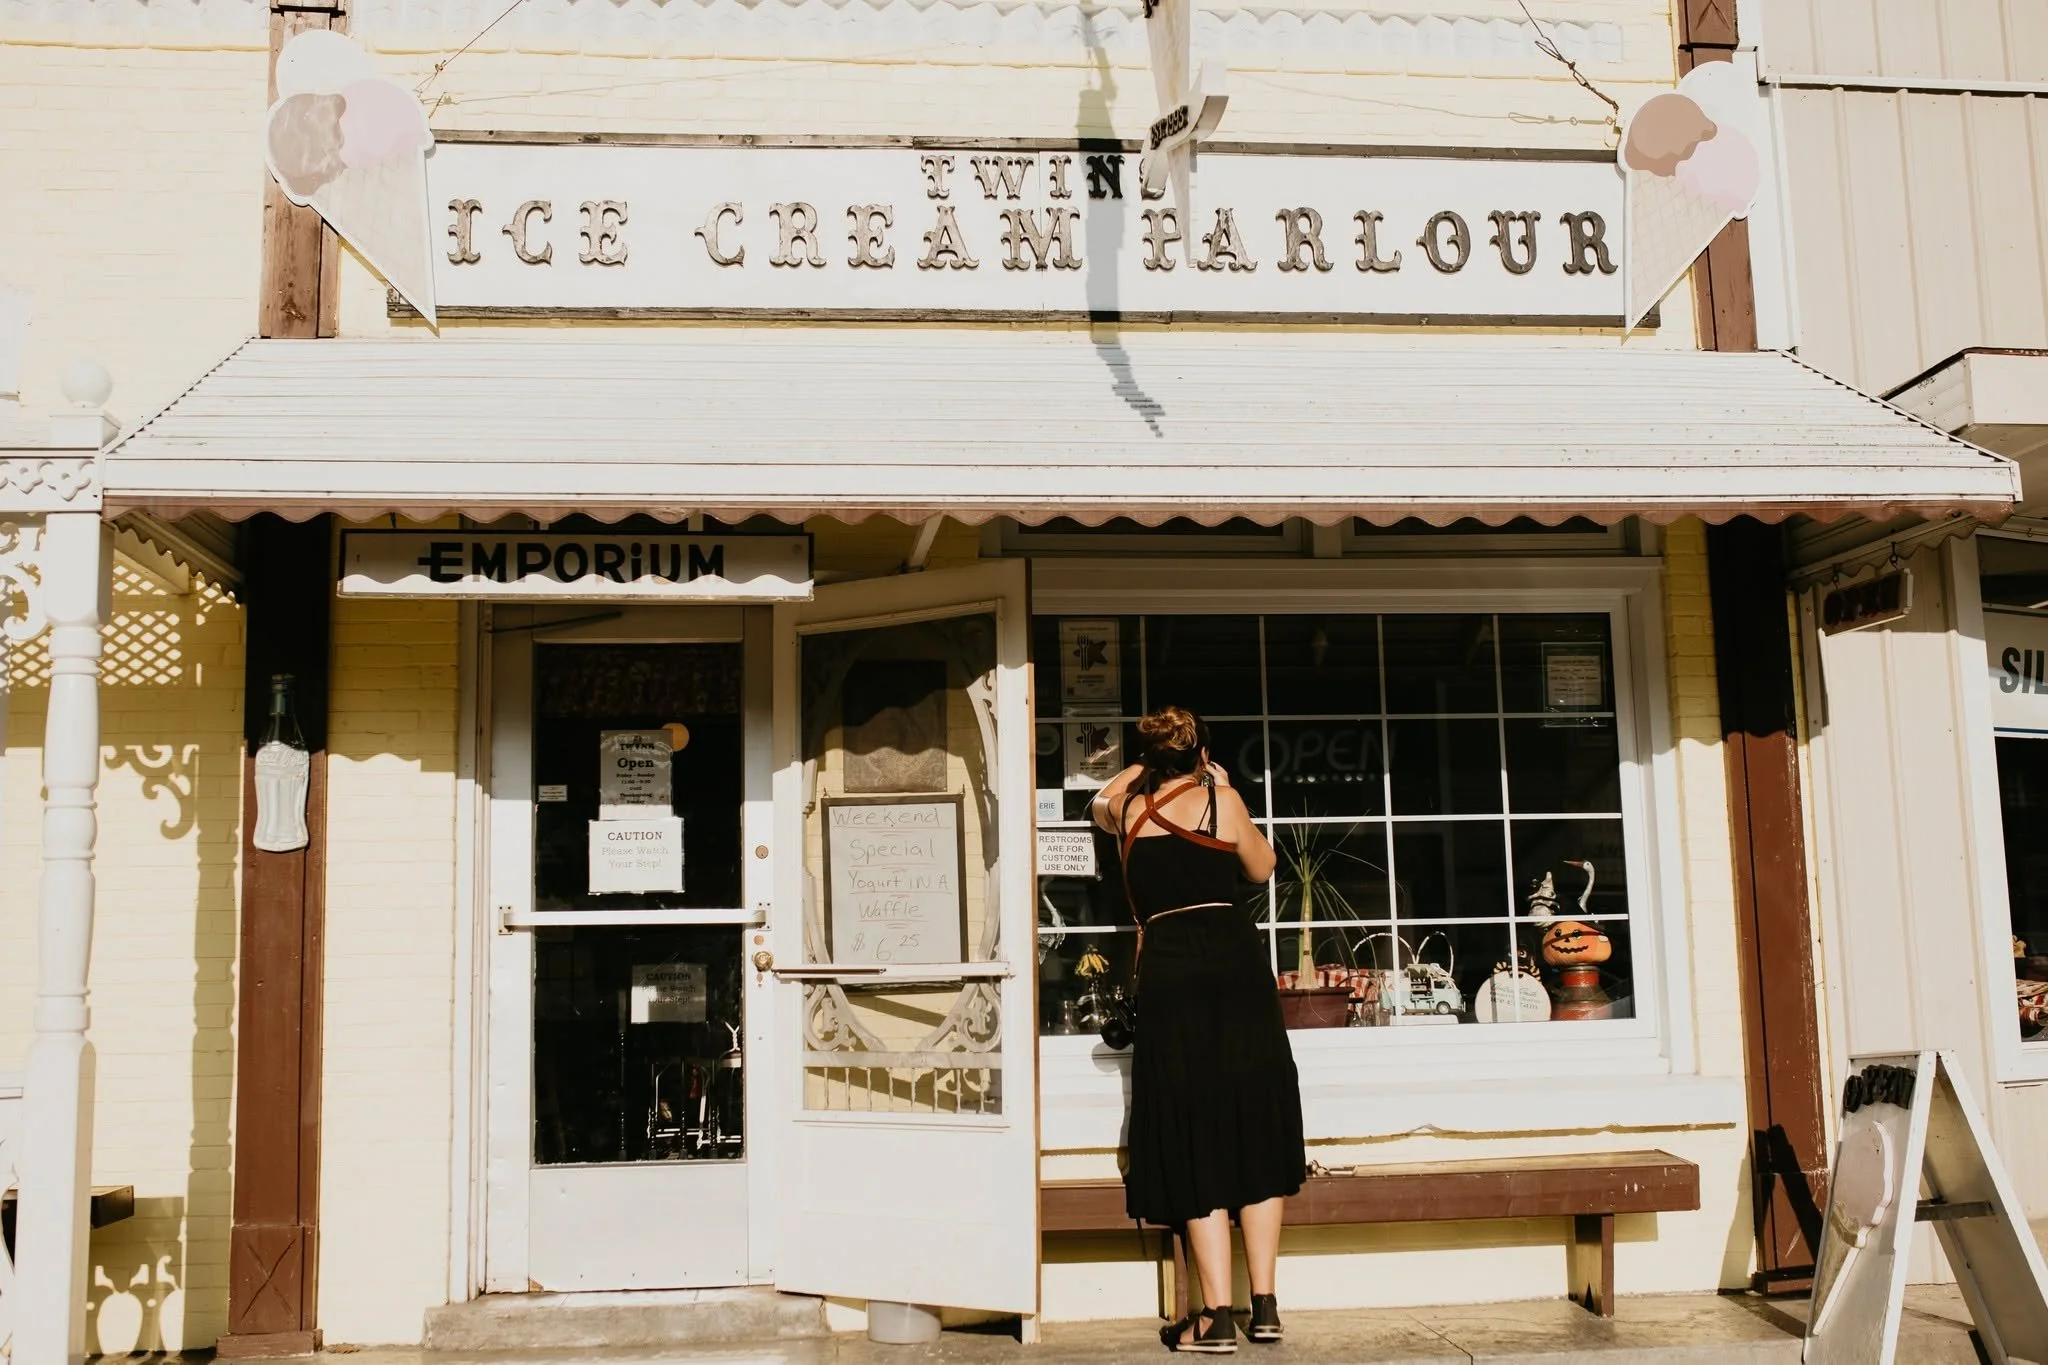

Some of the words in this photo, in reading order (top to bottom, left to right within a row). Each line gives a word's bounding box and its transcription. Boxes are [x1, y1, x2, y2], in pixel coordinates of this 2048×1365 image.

[920, 154, 1165, 201] TWIN
[447, 198, 628, 267] ICE
[695, 203, 1083, 271] CREAM
[1141, 206, 1619, 275] PARLOUR
[617, 757, 654, 770] Open
[1238, 731, 1399, 783] OPEN
[833, 807, 940, 827] Weekend
[607, 832, 663, 841] CAUTION
[850, 839, 935, 864] Special
[848, 870, 901, 893] Yogurt
[858, 900, 924, 919] Waffle
[646, 972, 691, 981] CAUTION
